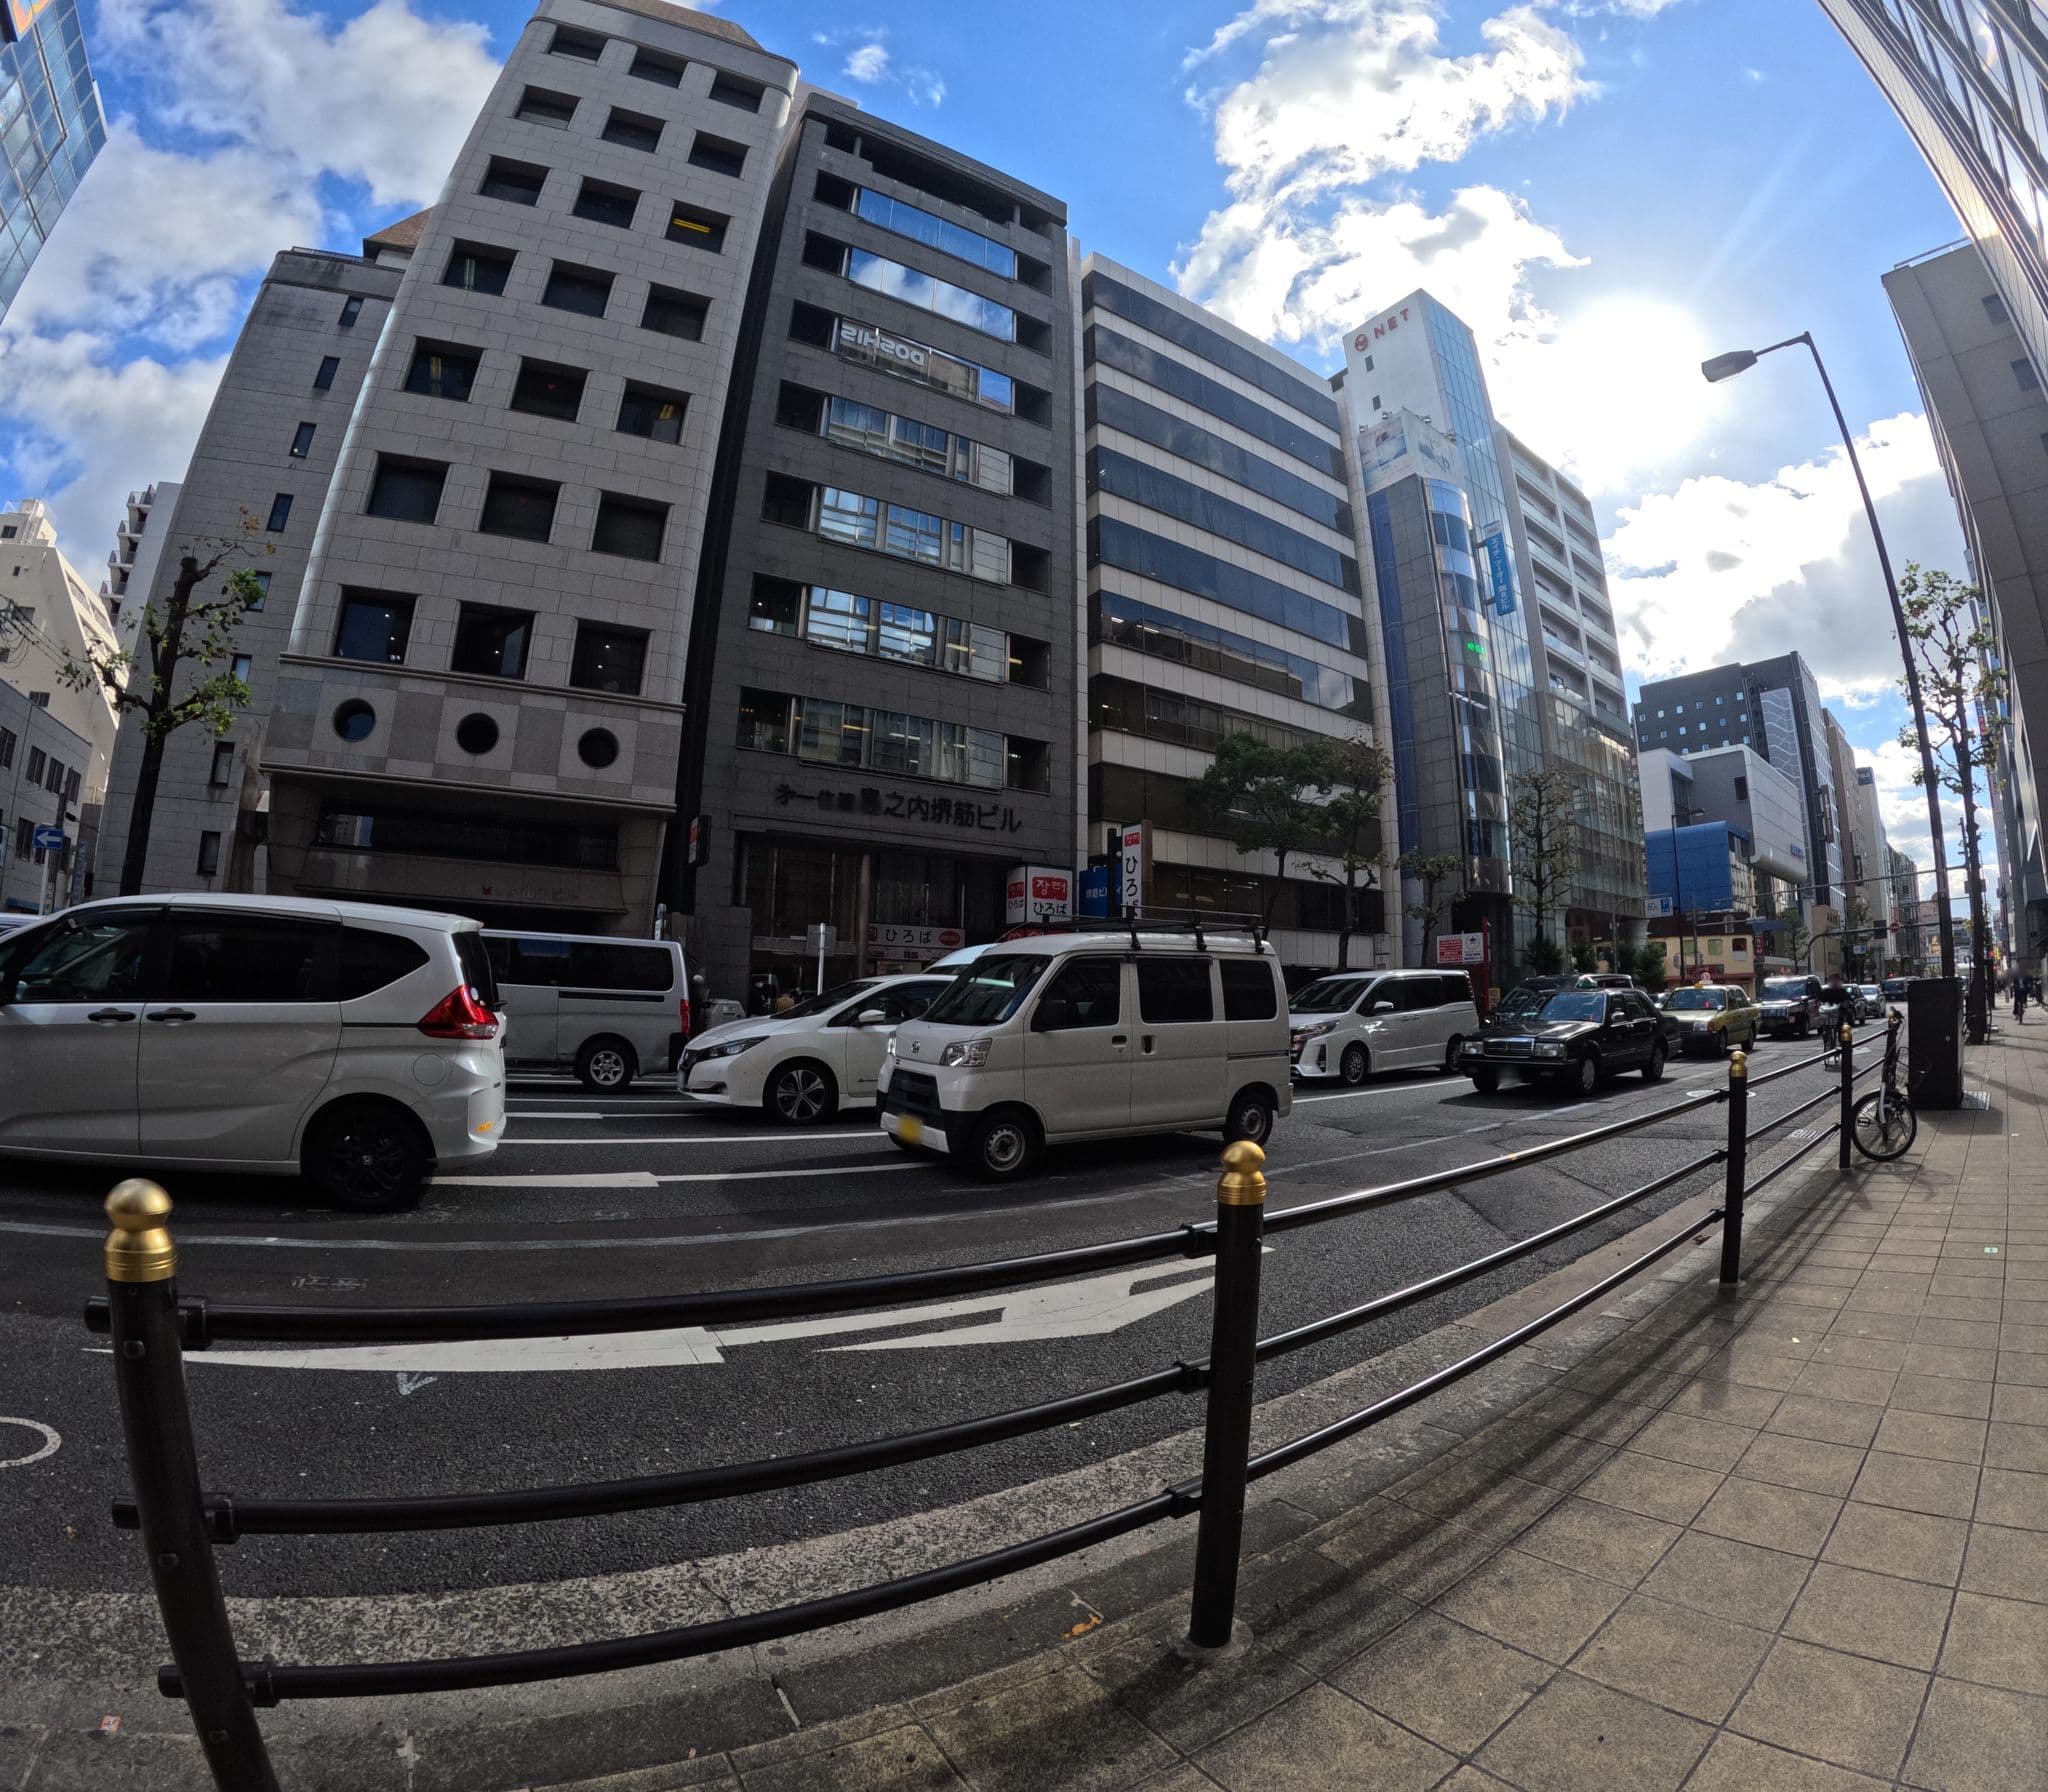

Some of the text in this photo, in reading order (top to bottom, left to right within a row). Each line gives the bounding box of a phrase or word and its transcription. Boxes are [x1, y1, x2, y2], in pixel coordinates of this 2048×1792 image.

[1374, 308, 1408, 339] NET
[1033, 902, 1067, 915] ひろば
[885, 929, 932, 943] ひろば
